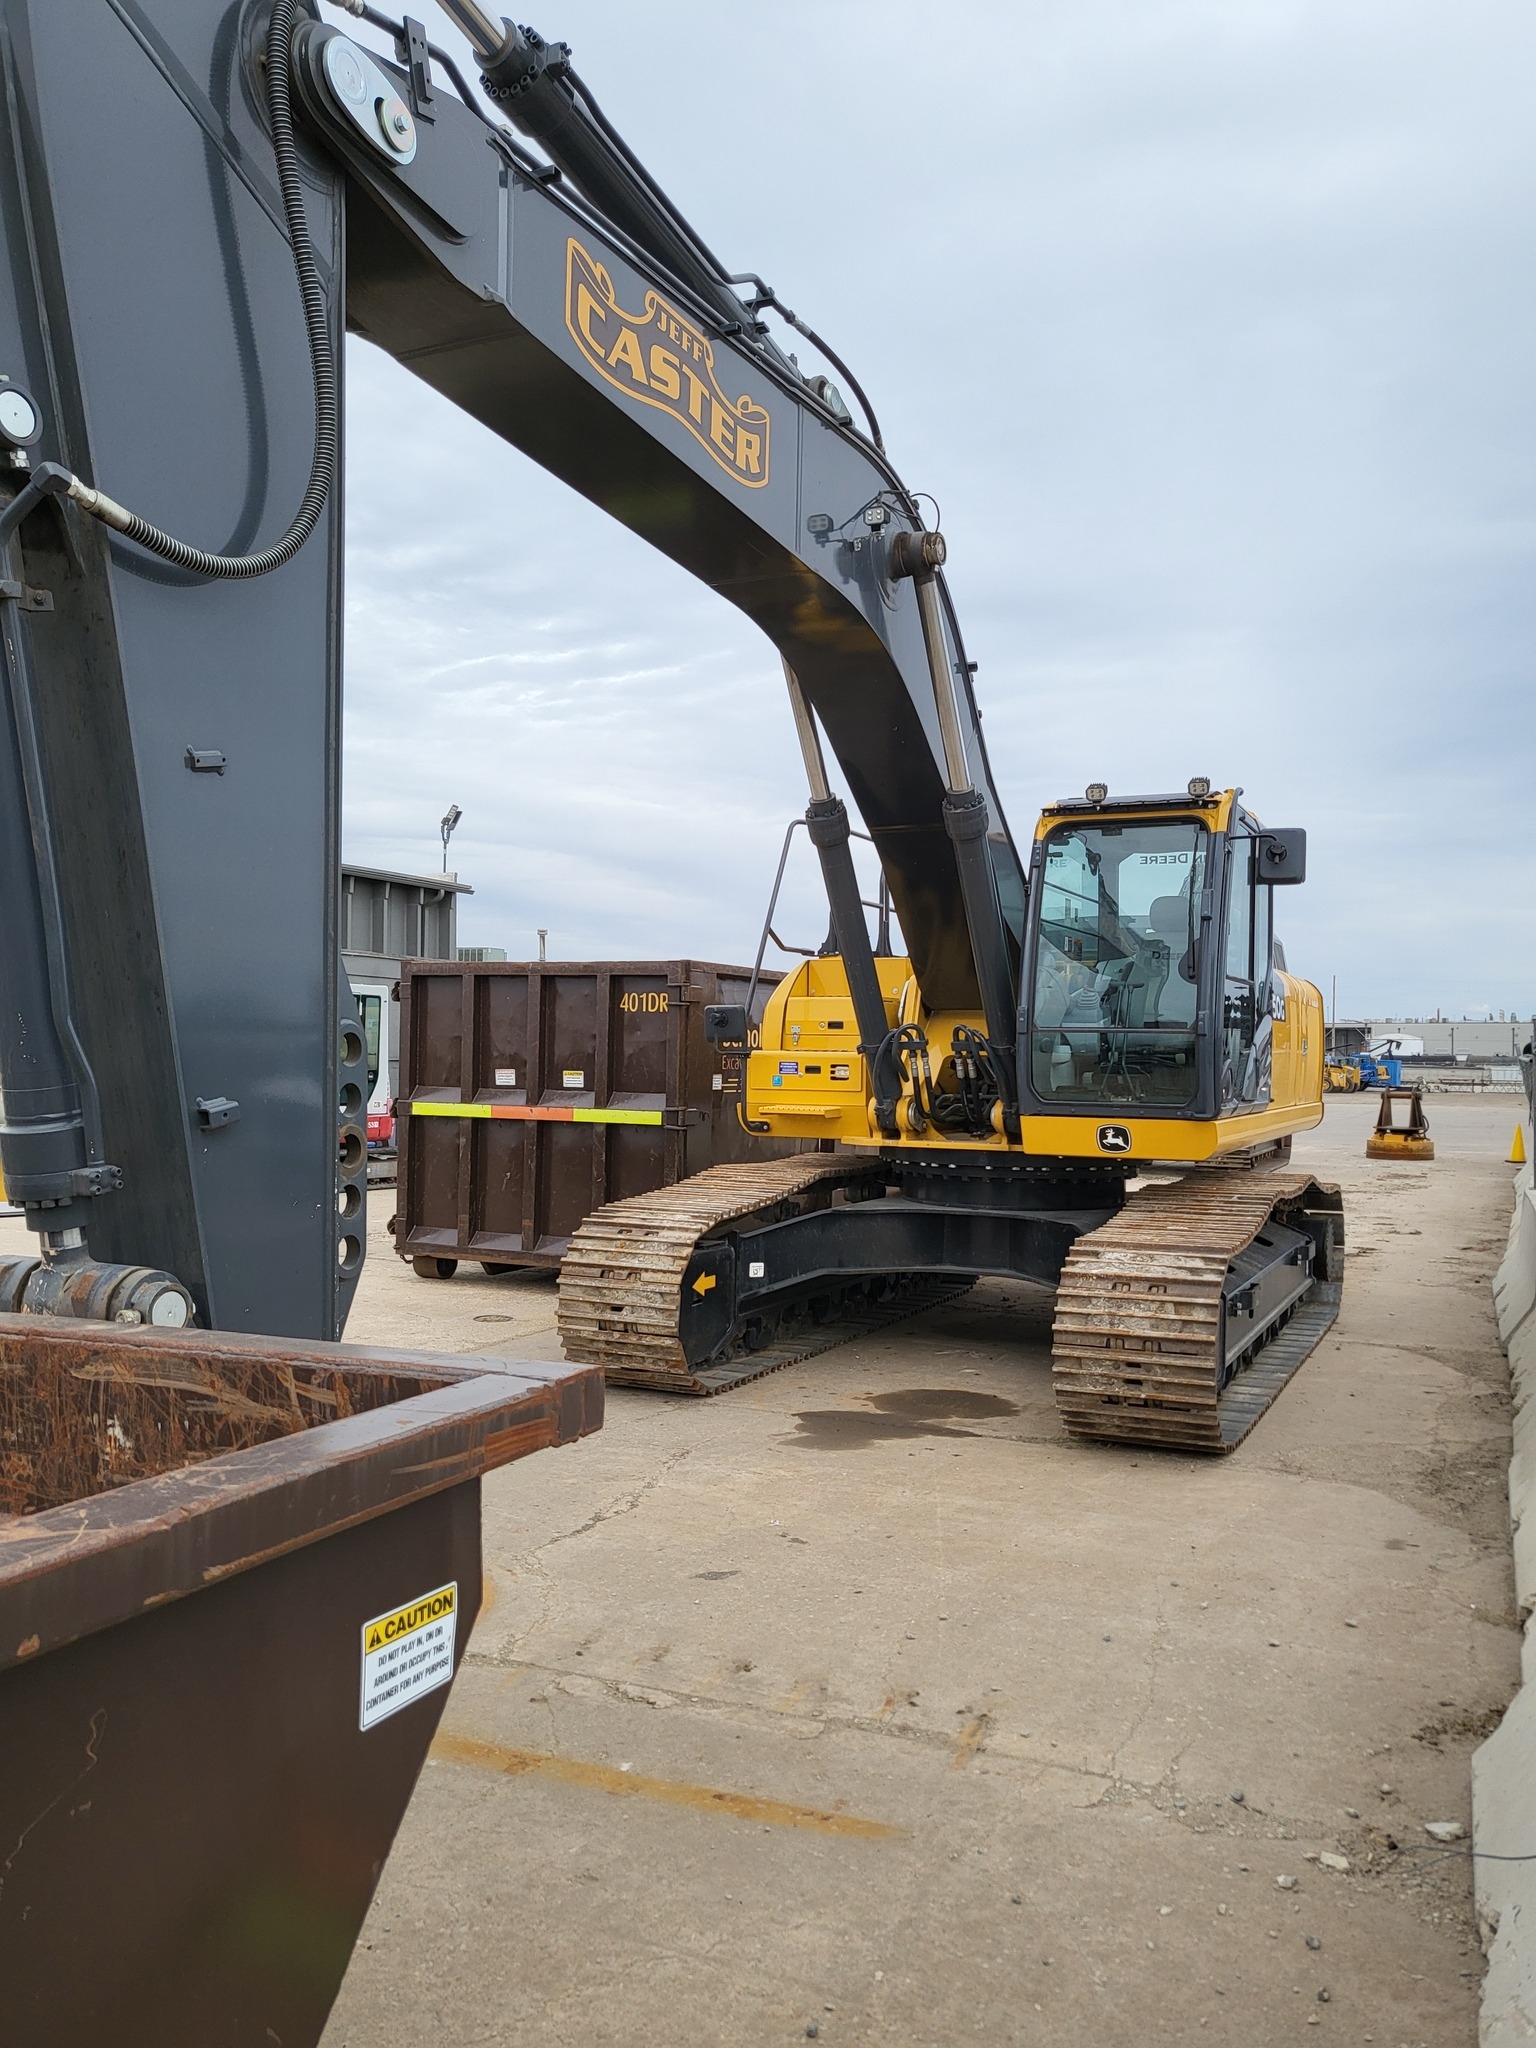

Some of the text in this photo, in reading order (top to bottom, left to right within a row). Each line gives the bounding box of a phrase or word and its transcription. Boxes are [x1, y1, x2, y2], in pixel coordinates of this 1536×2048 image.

[656, 309, 704, 362] JEFF
[577, 282, 761, 474] CASTER
[619, 992, 669, 1013] 401DR
[384, 1590, 454, 1639] CAUTION
[373, 1641, 446, 1688] AROUND OR OCCUPY THIS
[378, 1655, 387, 1667] DO
[388, 1648, 400, 1663] NOT
[401, 1639, 416, 1655] PLAY
[425, 1630, 434, 1642] ON
[434, 1625, 443, 1637] OR
[365, 1655, 450, 1711] CONTAINER FOR ANY PURPOSE
